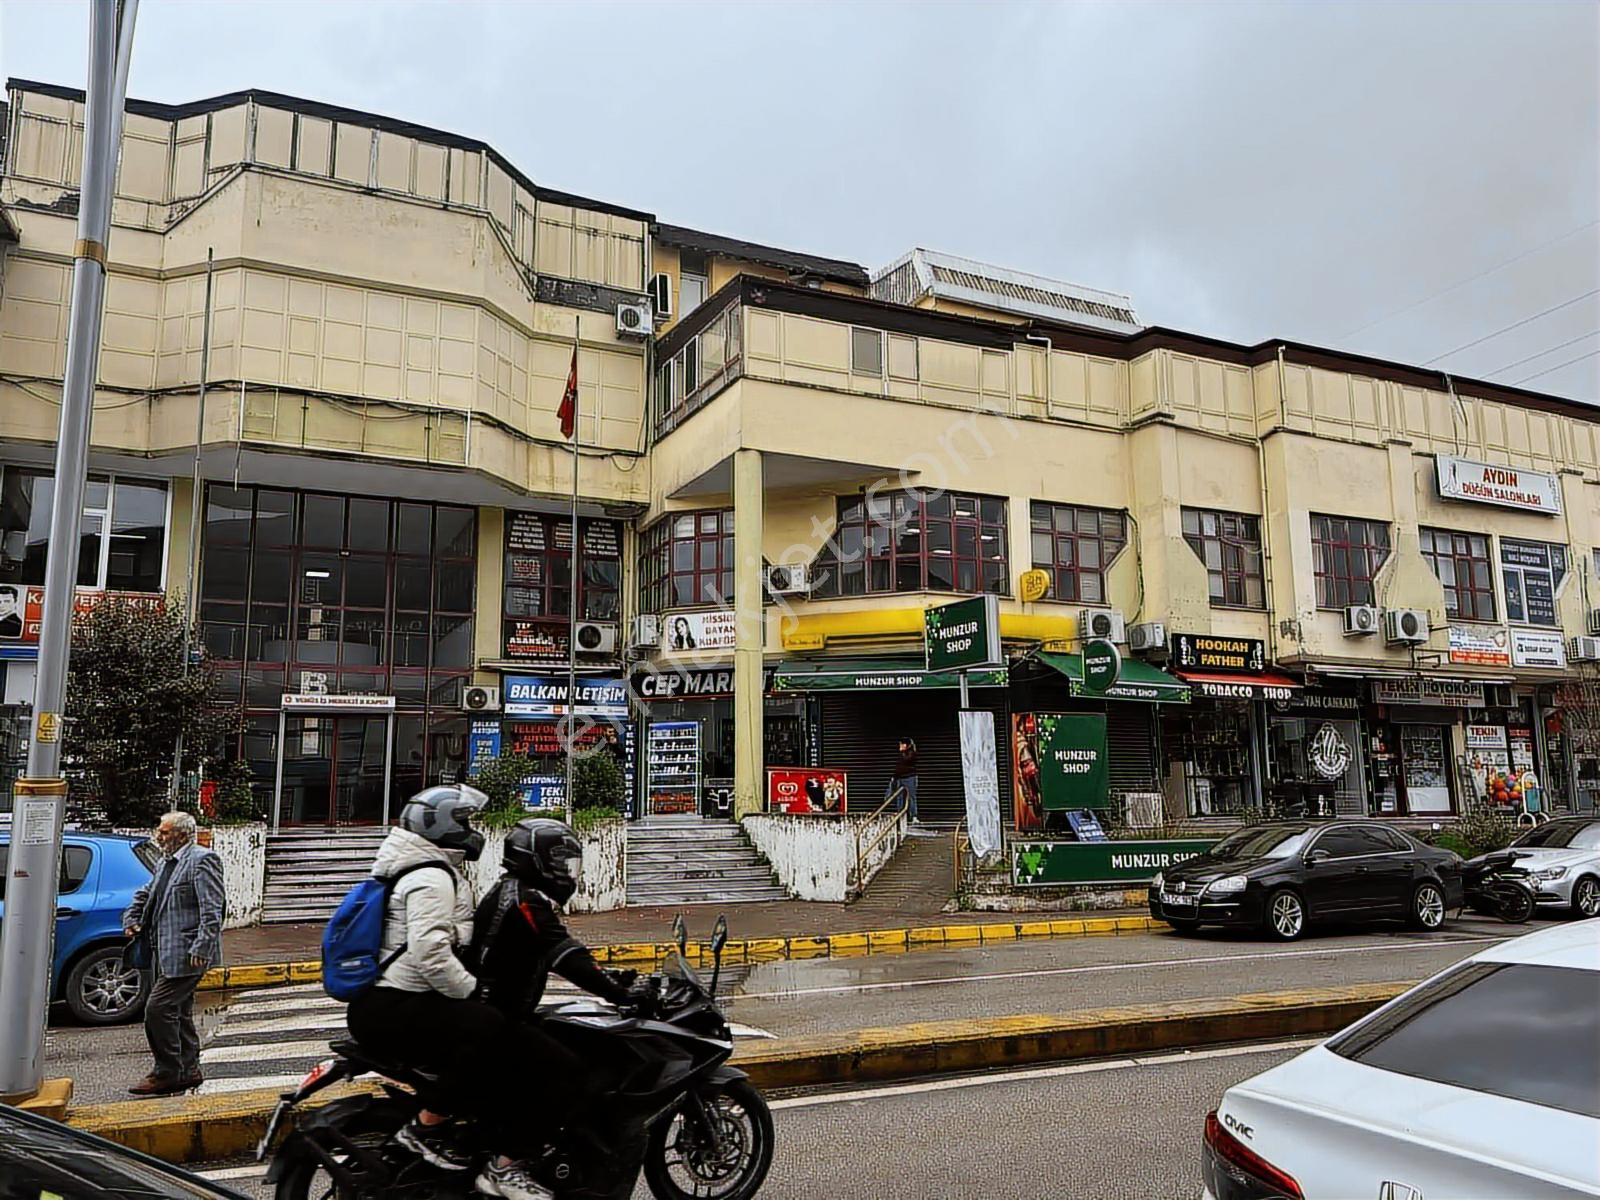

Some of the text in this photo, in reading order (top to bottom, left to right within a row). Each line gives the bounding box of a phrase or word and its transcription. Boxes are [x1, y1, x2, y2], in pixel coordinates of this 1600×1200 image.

[1483, 468, 1518, 487] AYDIN
[1494, 488, 1542, 506] SALONLARI
[939, 621, 979, 640] MUNZUR
[946, 638, 972, 653] SHOP
[1195, 638, 1249, 653] HOOKAH
[1201, 653, 1245, 667] FATHER
[641, 674, 680, 696] CEP
[855, 676, 923, 686] MUNZUR SHOP
[510, 684, 567, 700] BALKAN
[1138, 688, 1159, 698] SHOP
[1202, 683, 1292, 700] TOBACCO SHOP
[1055, 750, 1097, 761] MUNZUR
[1063, 762, 1091, 773] SHOP
[1111, 853, 1169, 869] MUNZUR
